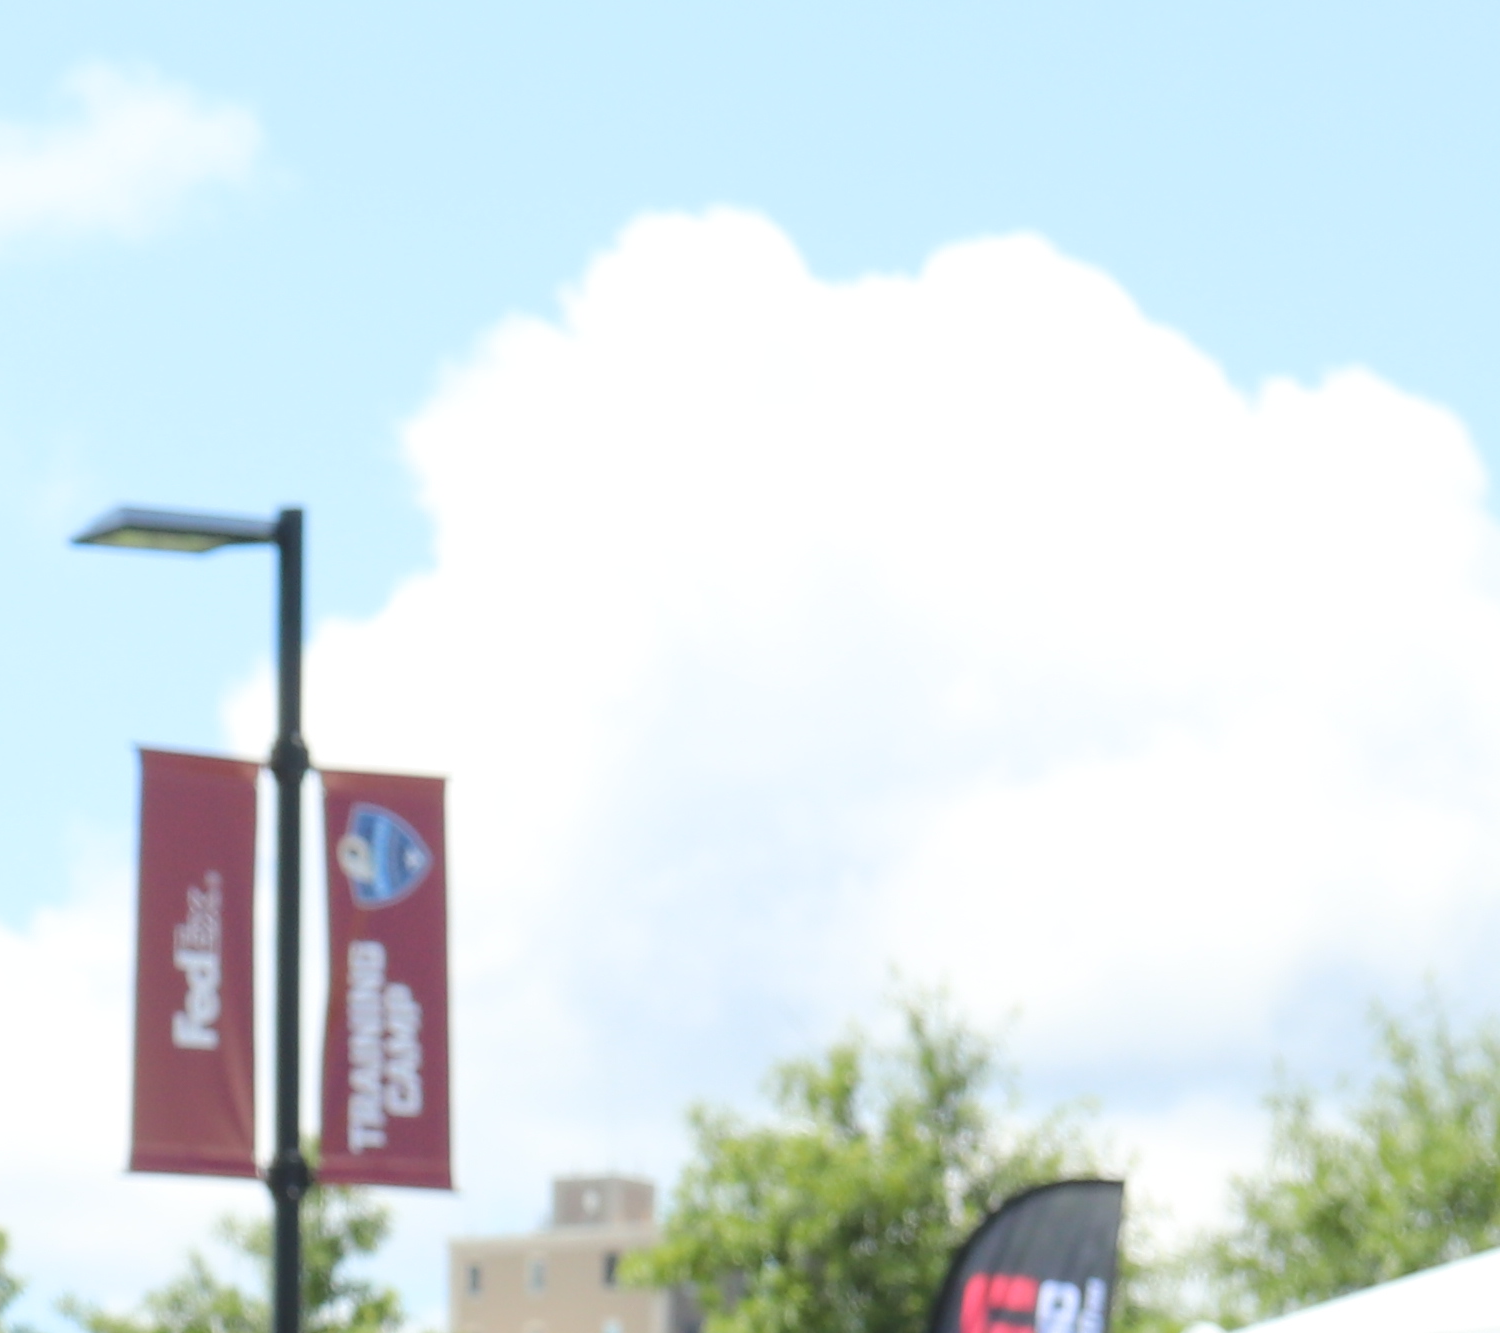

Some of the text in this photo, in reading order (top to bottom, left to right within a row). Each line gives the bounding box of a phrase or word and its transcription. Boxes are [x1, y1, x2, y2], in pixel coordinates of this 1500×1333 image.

[171, 885, 223, 1051] FedEx
[348, 941, 388, 1153] TRAINING
[386, 982, 423, 1118] CAMP
